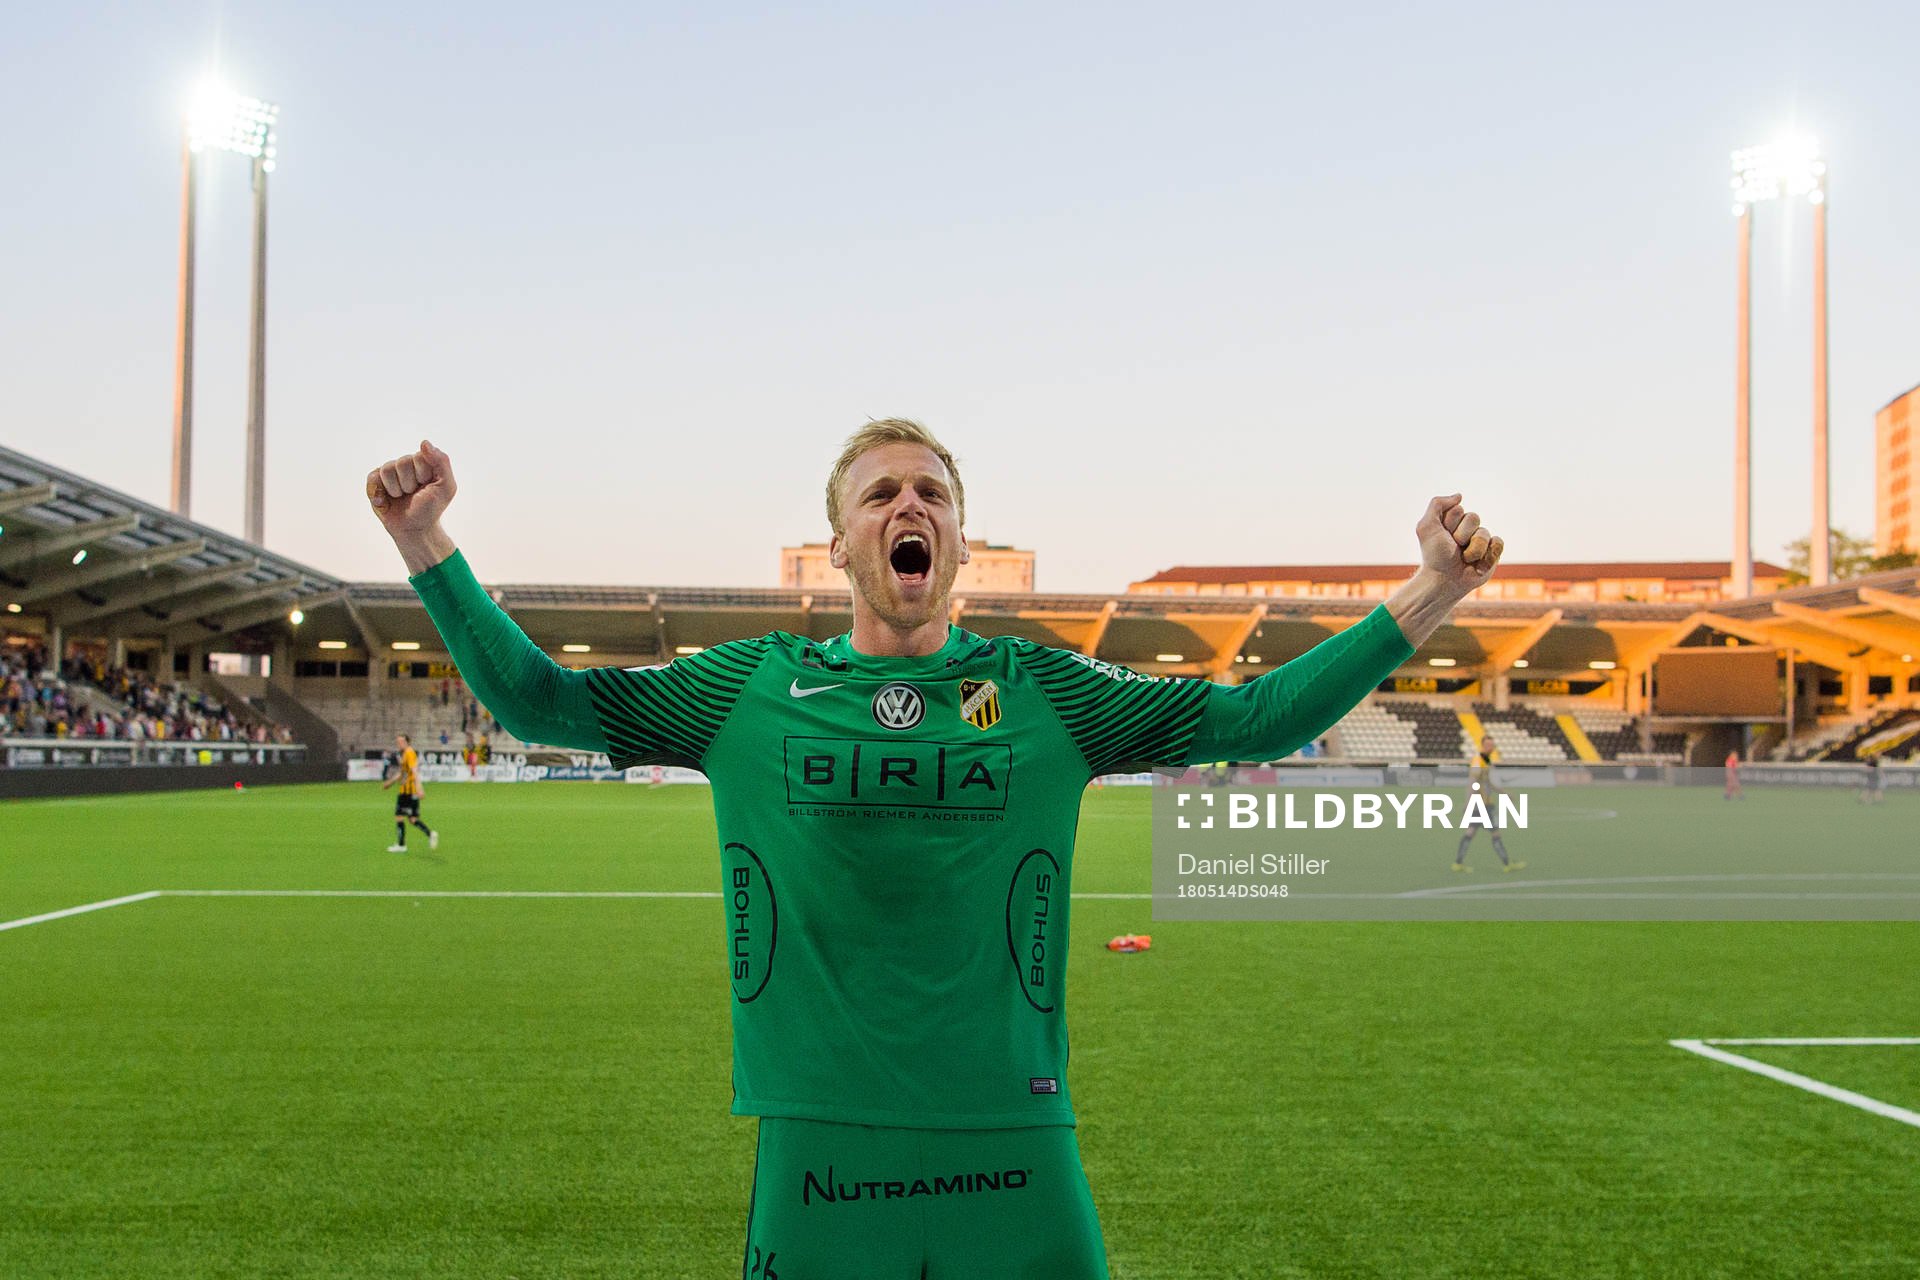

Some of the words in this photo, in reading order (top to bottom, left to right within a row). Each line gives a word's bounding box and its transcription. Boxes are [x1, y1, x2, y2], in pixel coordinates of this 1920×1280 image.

[863, 809, 917, 820] RIEMER
[922, 811, 1005, 823] ANDERSSON
[733, 866, 750, 980] BOHUS
[1030, 873, 1052, 988] BOHUS
